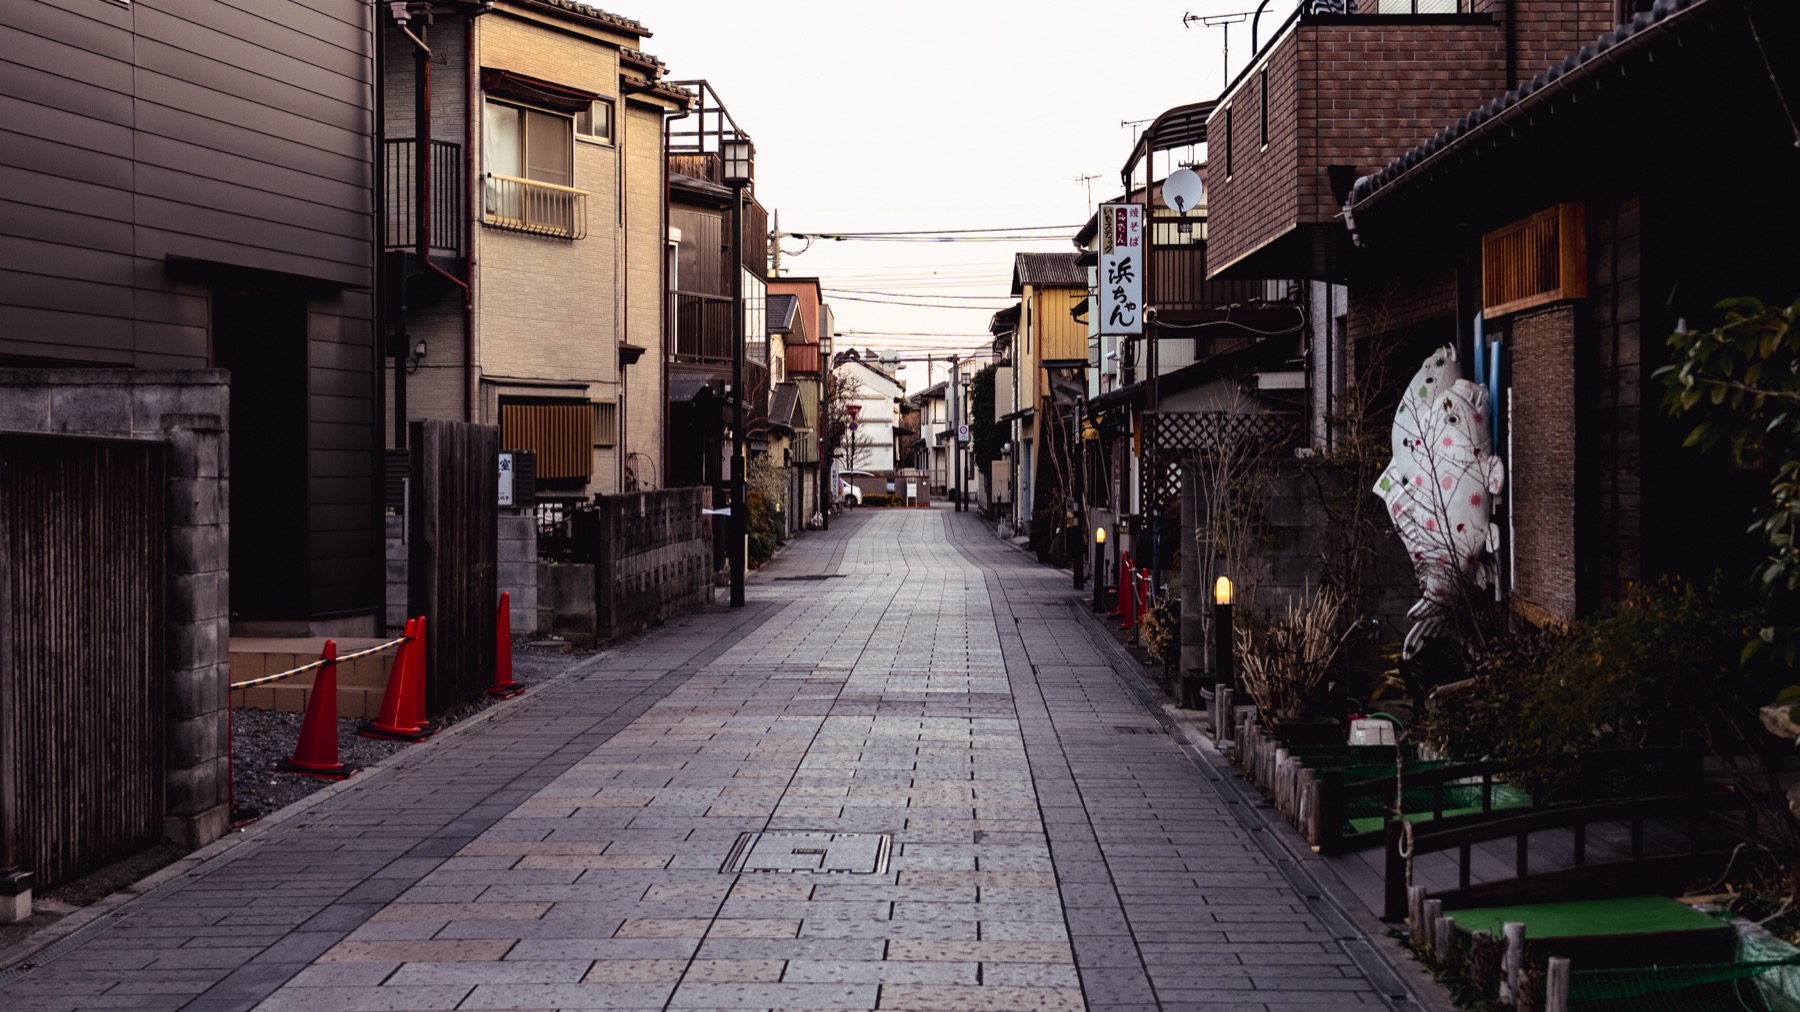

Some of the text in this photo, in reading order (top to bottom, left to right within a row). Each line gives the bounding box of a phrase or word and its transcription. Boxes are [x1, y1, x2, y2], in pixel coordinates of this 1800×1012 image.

[1129, 208, 1140, 247] 焼そば
[1108, 256, 1136, 327] 浜ちゃん
